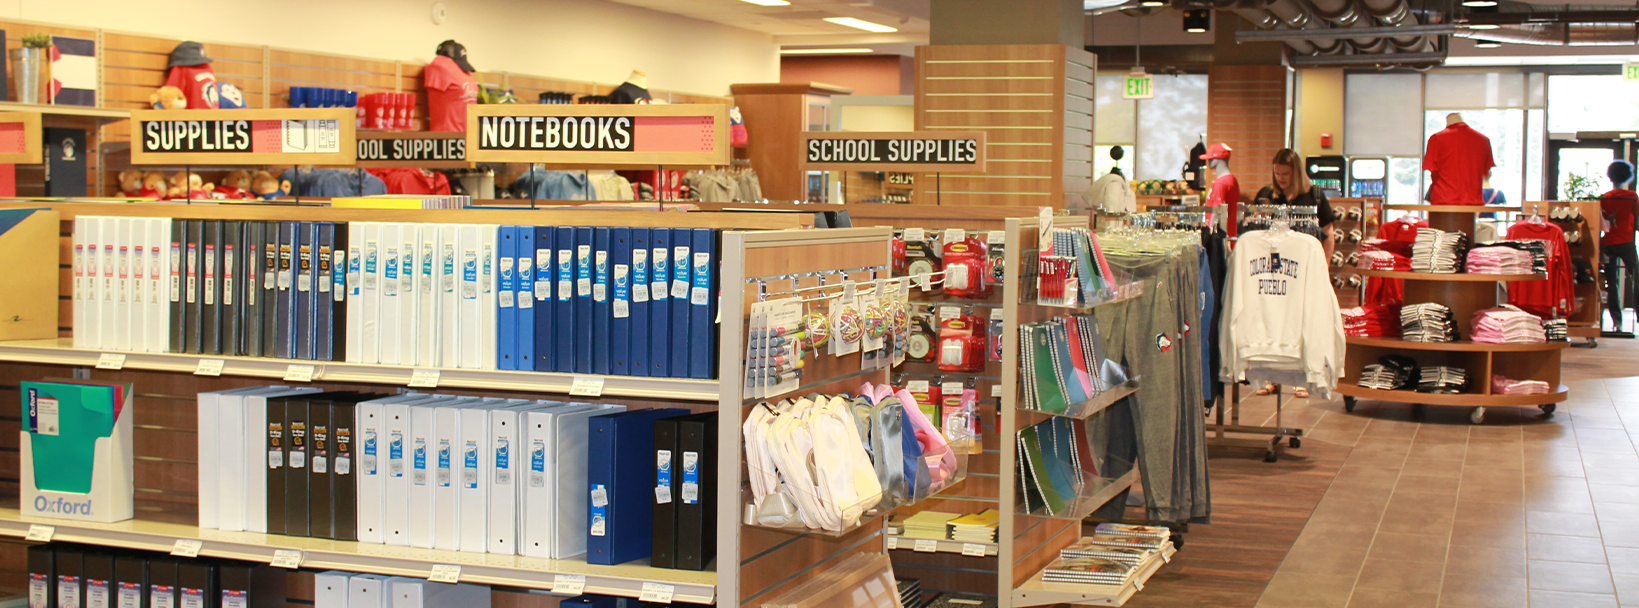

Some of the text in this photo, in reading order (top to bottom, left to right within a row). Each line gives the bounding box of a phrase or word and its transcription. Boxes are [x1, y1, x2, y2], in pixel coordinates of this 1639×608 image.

[1126, 78, 1150, 96] EXIT
[146, 120, 250, 151] SUPPLIES
[481, 116, 631, 150] NOTEBOOKS
[356, 139, 466, 160] OOL SUPPLIES
[808, 139, 977, 162] SCHOOL SUPPLIES
[1250, 257, 1298, 279] COLORA STATE
[1258, 279, 1287, 296] PUEBLO
[34, 495, 92, 516] Oxford
